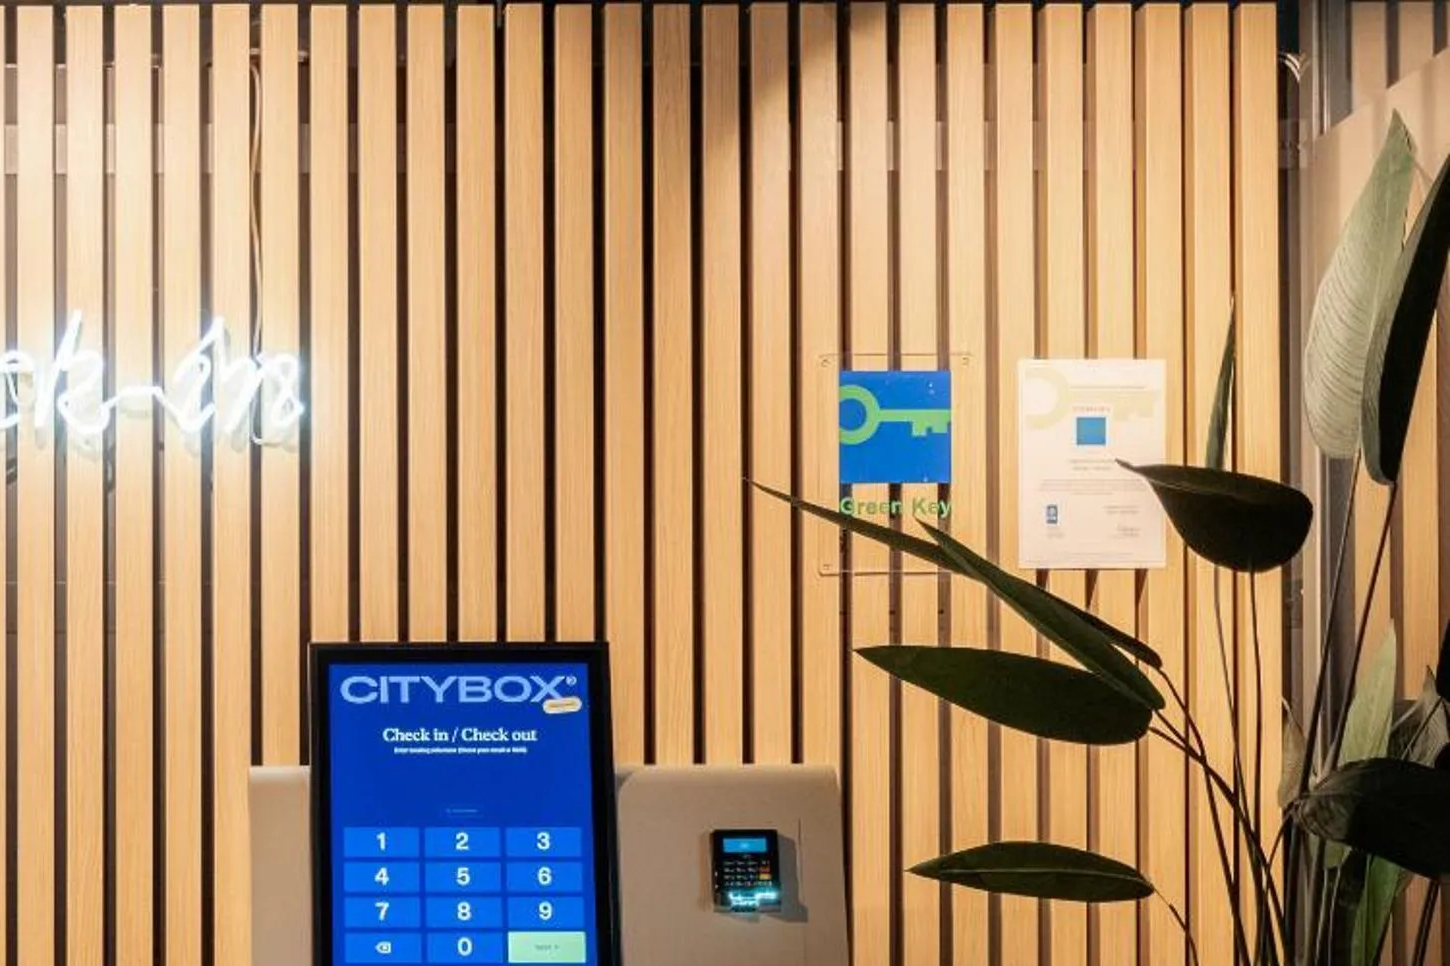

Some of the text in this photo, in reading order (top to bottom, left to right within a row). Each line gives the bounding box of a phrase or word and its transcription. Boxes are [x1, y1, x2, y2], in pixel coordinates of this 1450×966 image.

[840, 497, 950, 518] Green Key
[382, 727, 431, 742] Check
[433, 727, 449, 742] in
[461, 727, 509, 742] Check
[512, 729, 538, 742] out
[376, 833, 550, 849] 1 2 3
[375, 868, 551, 884] 4 5 6
[376, 903, 552, 920] 7 8 9
[458, 938, 472, 955] 0
